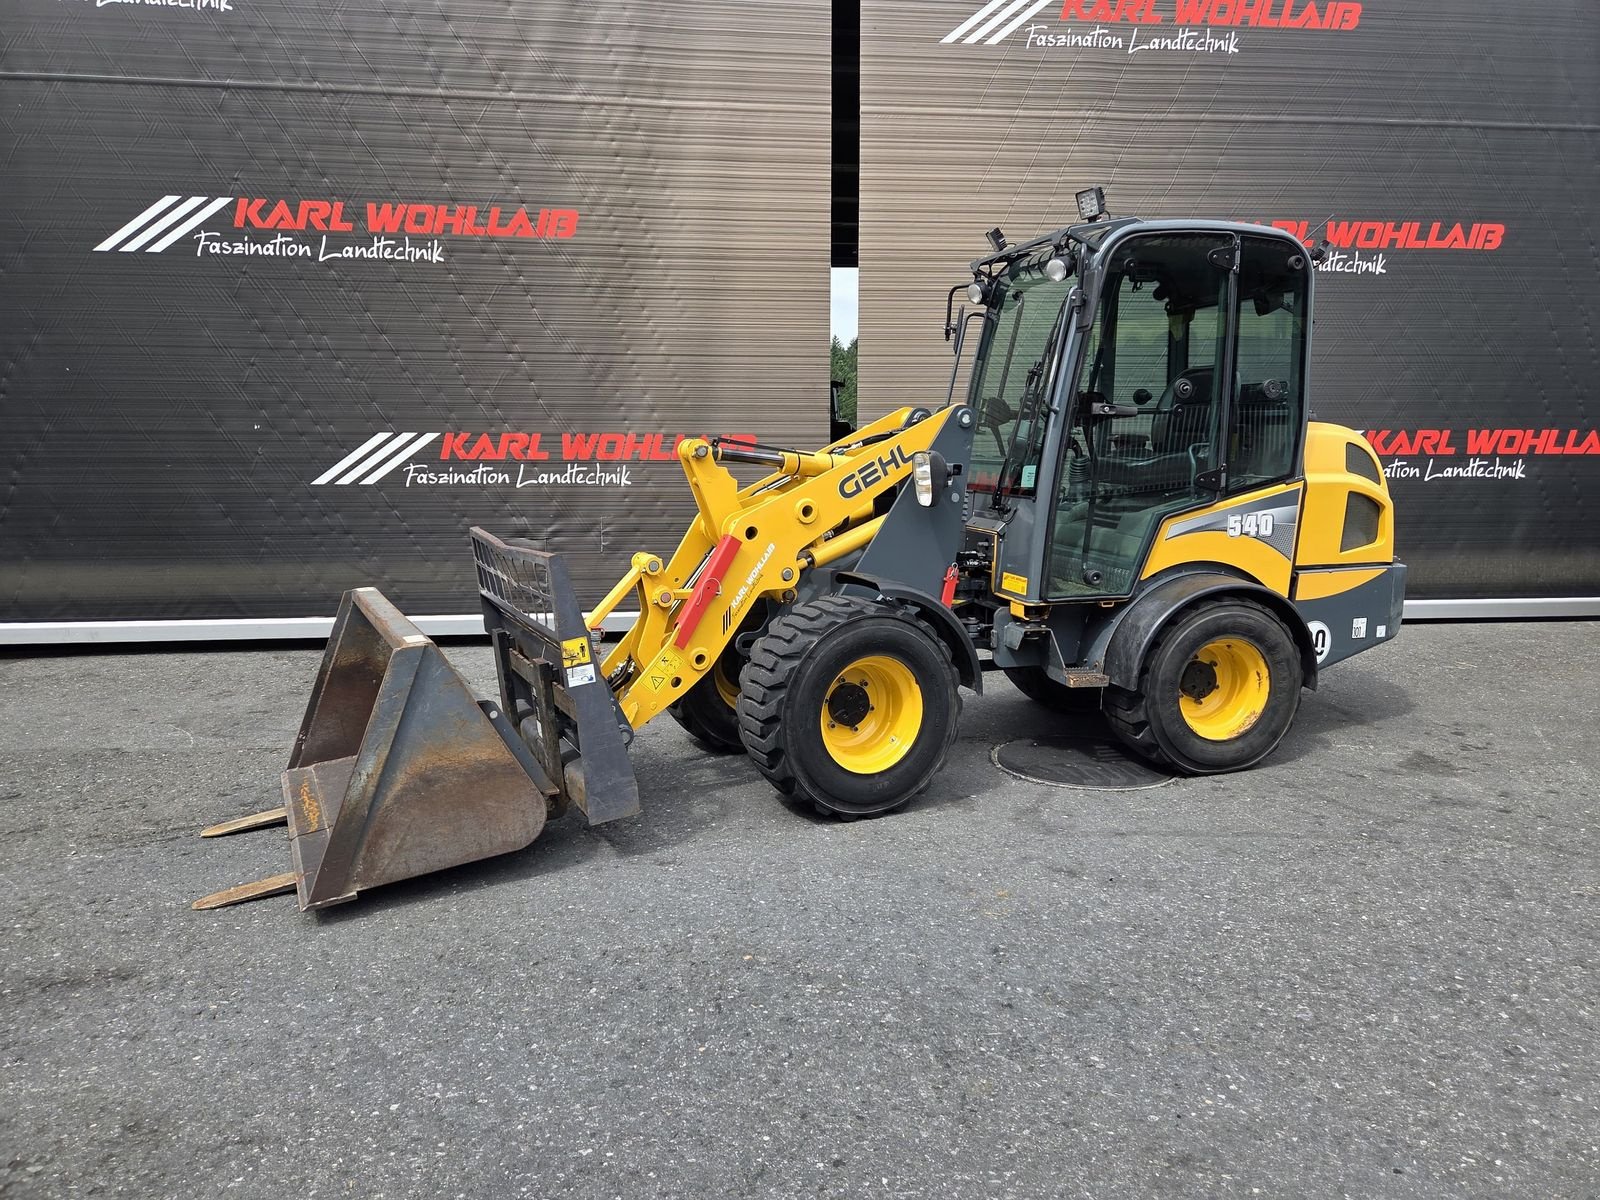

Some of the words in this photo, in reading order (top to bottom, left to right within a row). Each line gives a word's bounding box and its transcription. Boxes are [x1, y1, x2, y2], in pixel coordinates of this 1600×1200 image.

[1060, 0, 1162, 24] KARL
[1025, 24, 1122, 49] Faszination
[1128, 27, 1239, 54] Landtechnik
[234, 197, 353, 232] KARL
[194, 230, 311, 256] Faszination
[319, 235, 444, 263] Landtechnik
[440, 432, 549, 460] KARL
[1366, 429, 1456, 455] KARL
[1466, 429, 1600, 455] WOHLLA
[403, 463, 509, 487] Faszination
[516, 463, 631, 488] Landtechnik
[839, 445, 914, 499] GEHL
[1424, 457, 1526, 482] Landtechnik
[1227, 514, 1273, 537] 540
[731, 585, 748, 609] KARL
